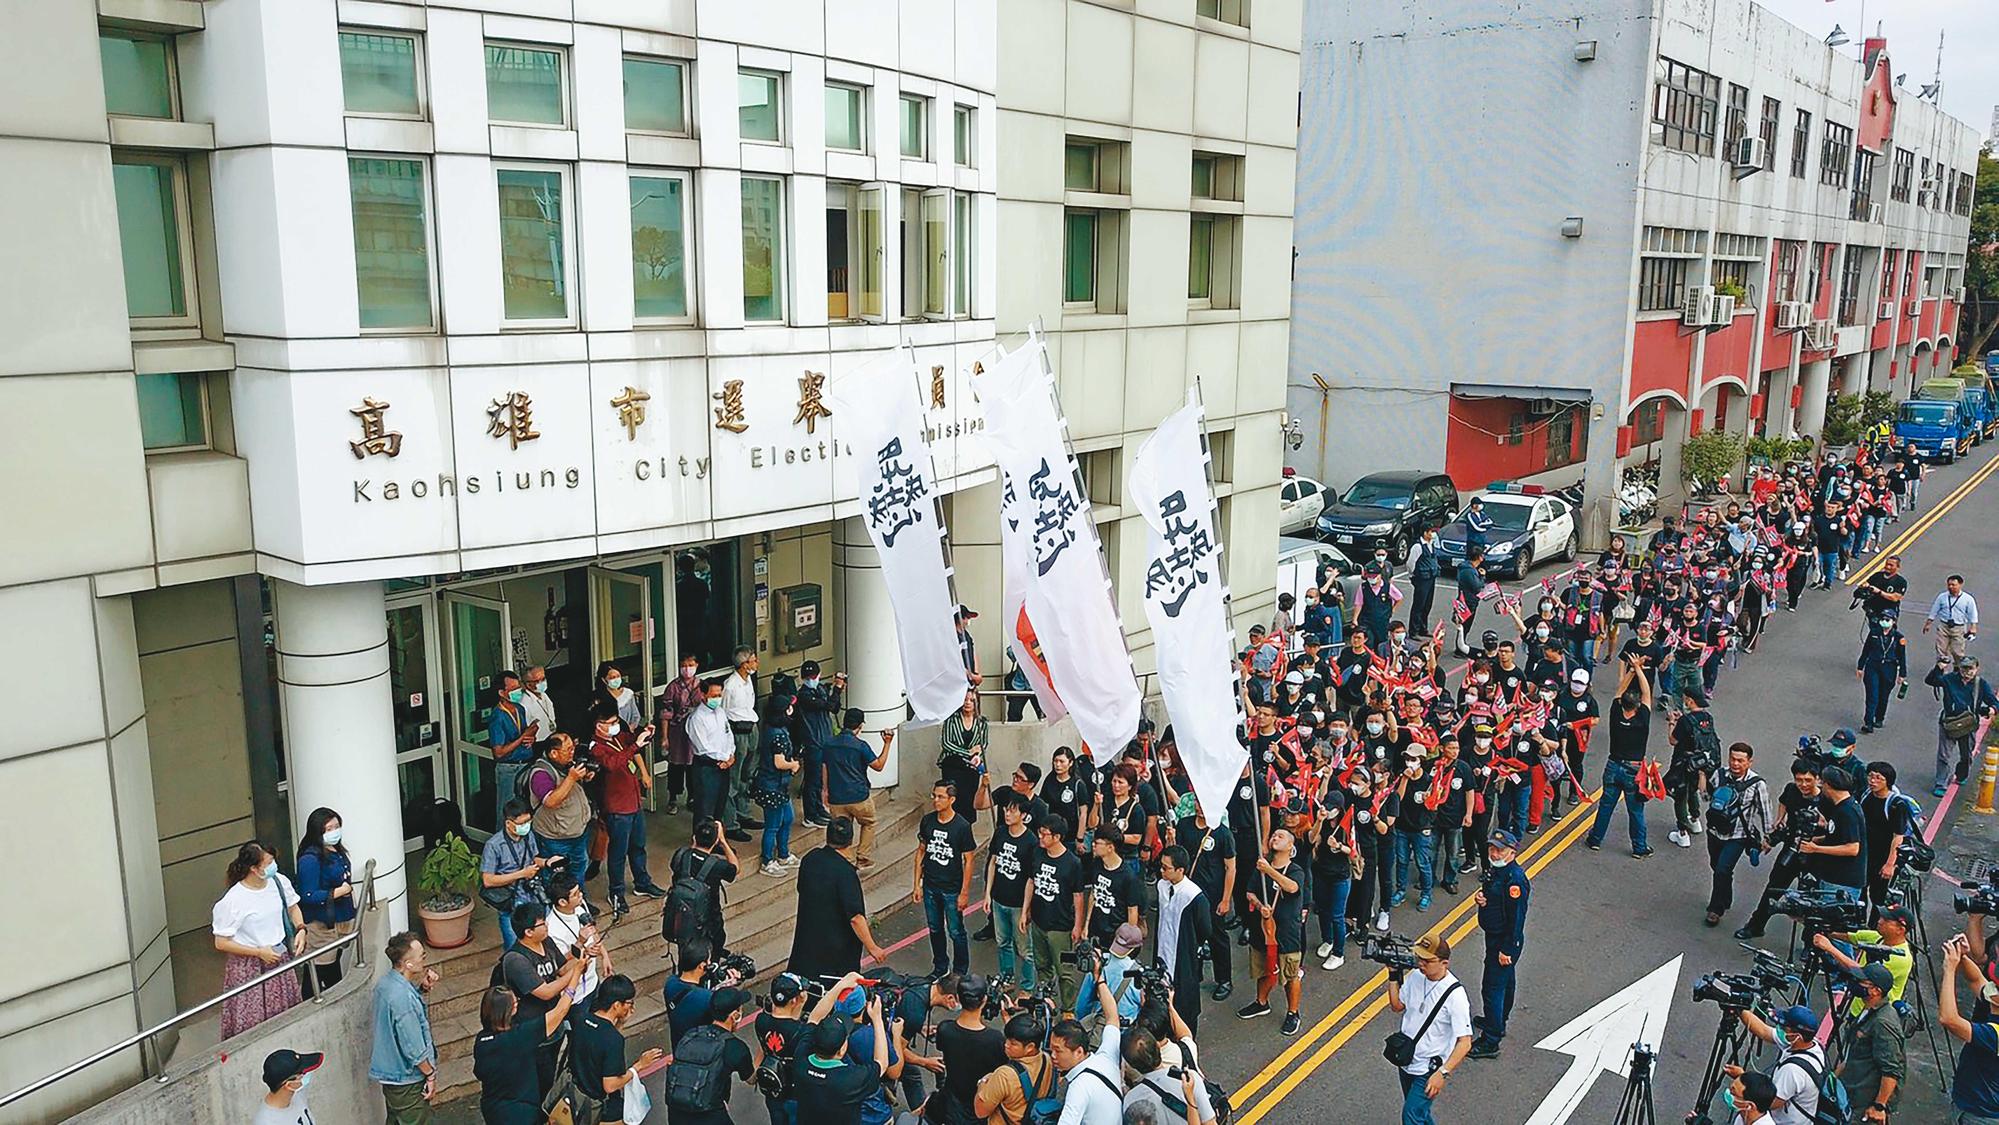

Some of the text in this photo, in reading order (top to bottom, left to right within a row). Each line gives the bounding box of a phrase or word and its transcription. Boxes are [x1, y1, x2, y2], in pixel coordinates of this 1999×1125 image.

[353, 466, 580, 503] Kaohsiung
[634, 454, 711, 481] City
[750, 438, 853, 469] Electi
